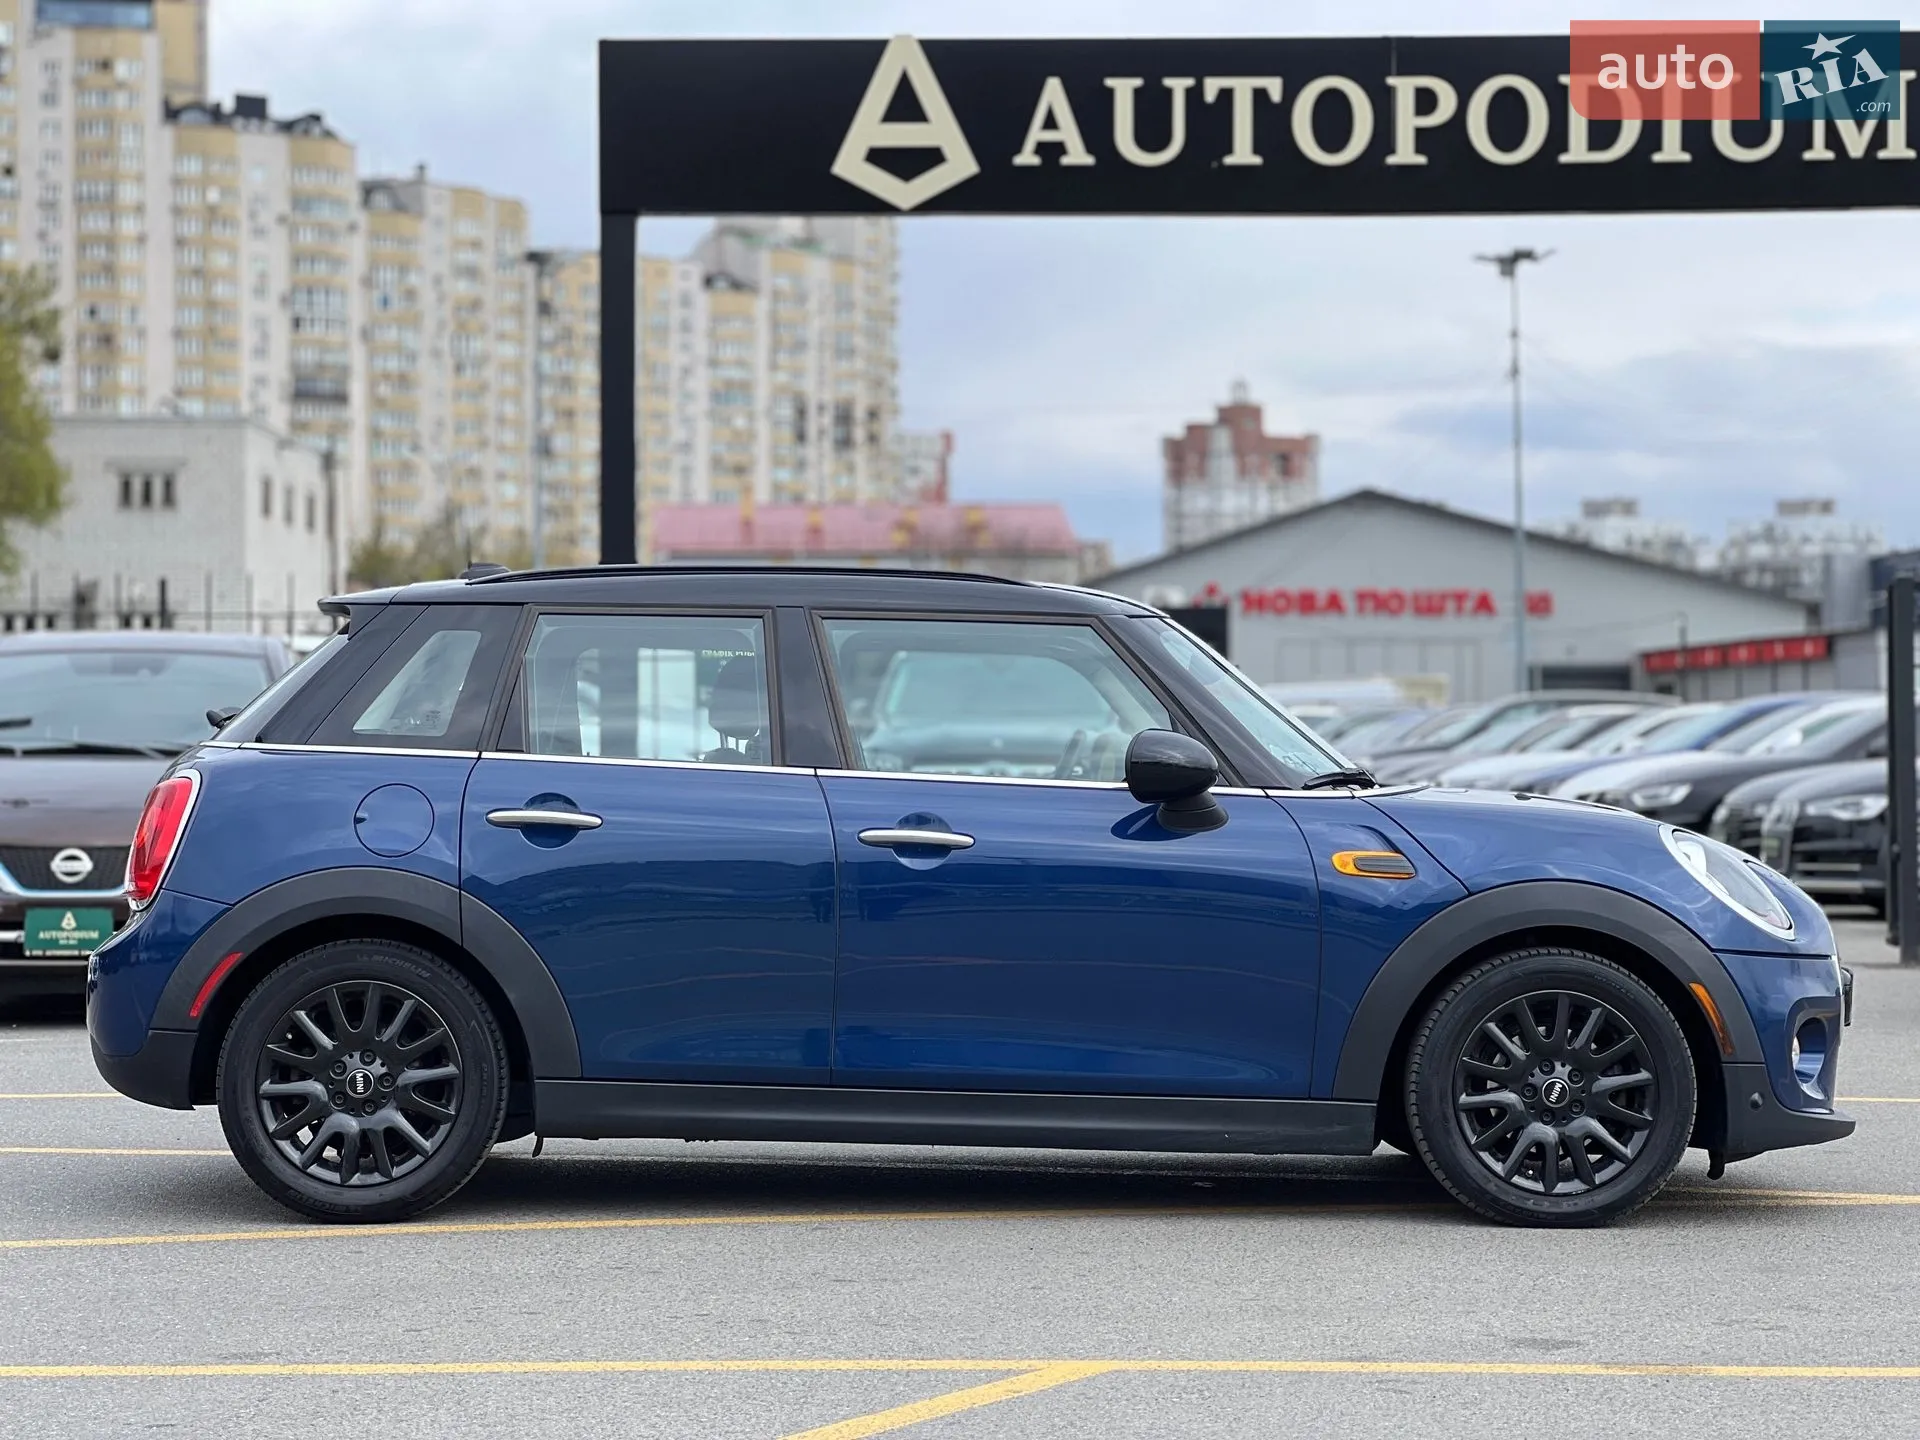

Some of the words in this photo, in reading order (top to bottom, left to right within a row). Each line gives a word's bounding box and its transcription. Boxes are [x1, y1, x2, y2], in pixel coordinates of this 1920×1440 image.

[1012, 70, 1917, 167] AUTOPODIUM
[1241, 590, 1345, 615] НОВА
[1354, 590, 1497, 615] ПОШТА
[355, 1072, 365, 1093] MINI
[1548, 1082, 1563, 1103] MINI
